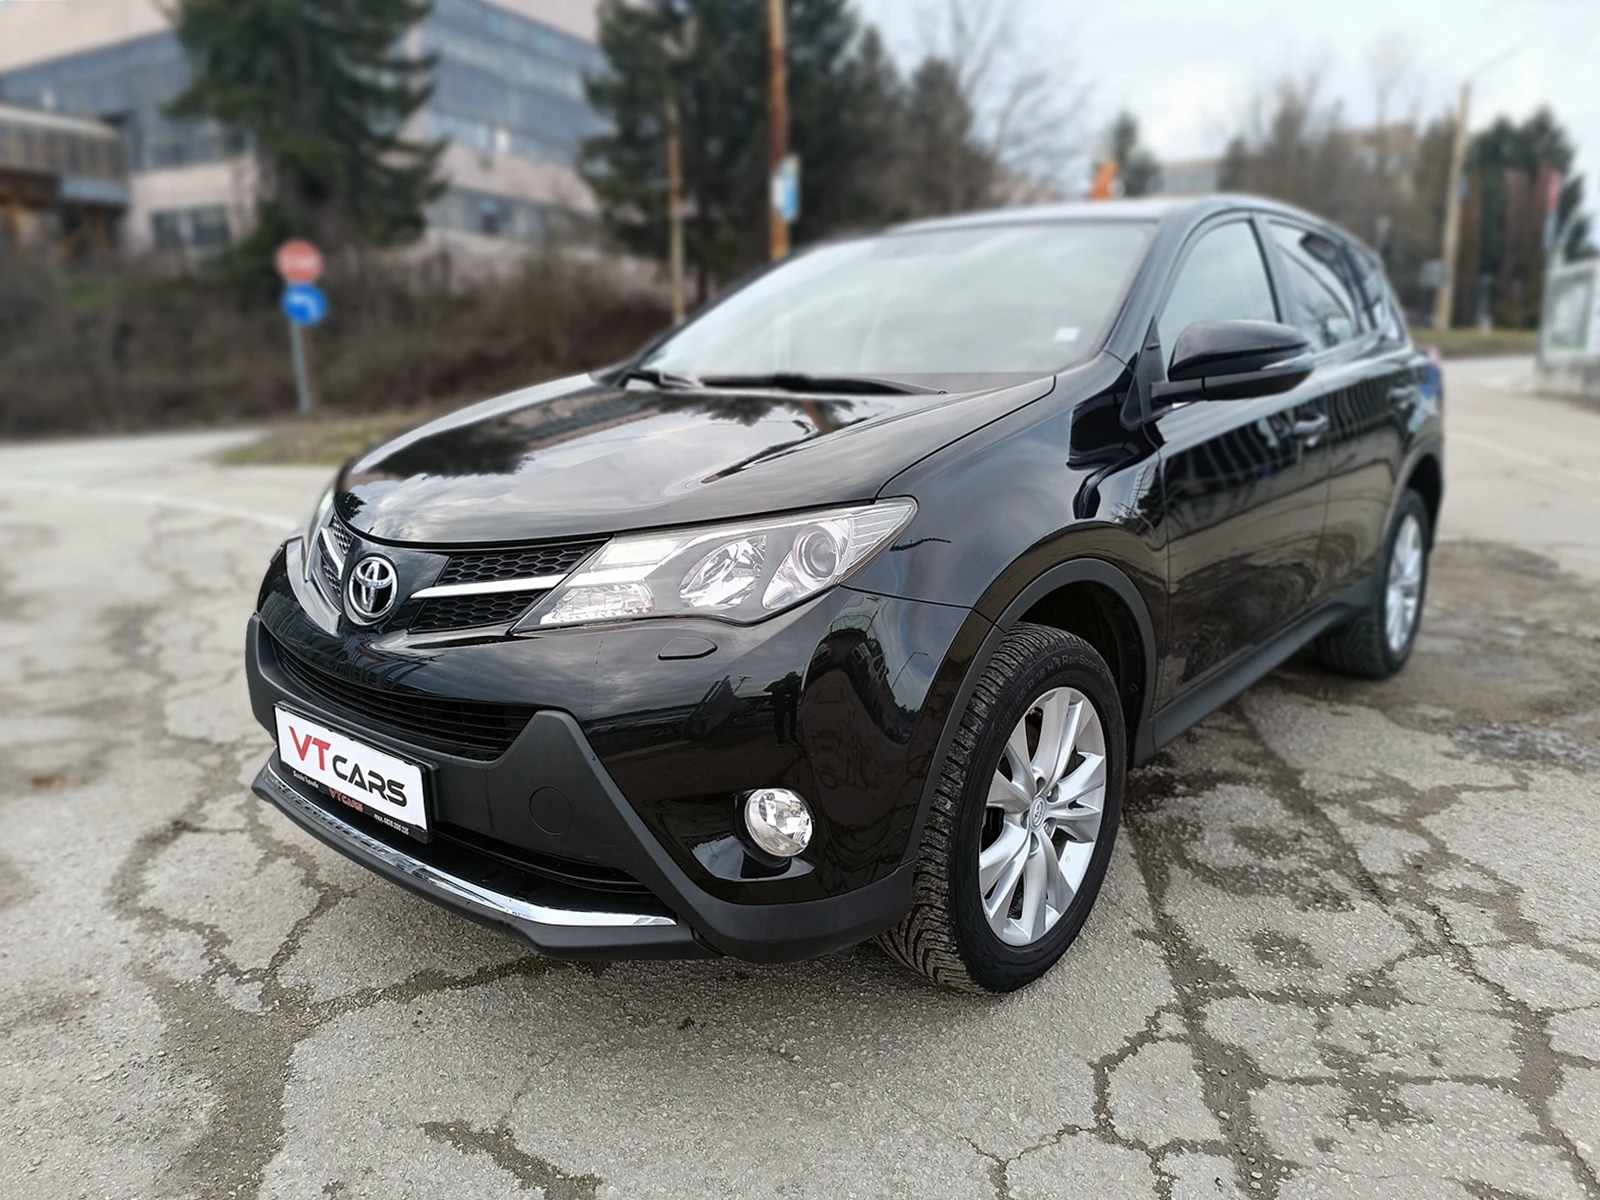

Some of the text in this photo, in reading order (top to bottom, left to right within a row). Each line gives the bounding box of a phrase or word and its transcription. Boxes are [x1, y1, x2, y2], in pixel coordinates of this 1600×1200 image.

[1061, 653, 1099, 673] RainSport
[288, 725, 407, 808] VT CARS
